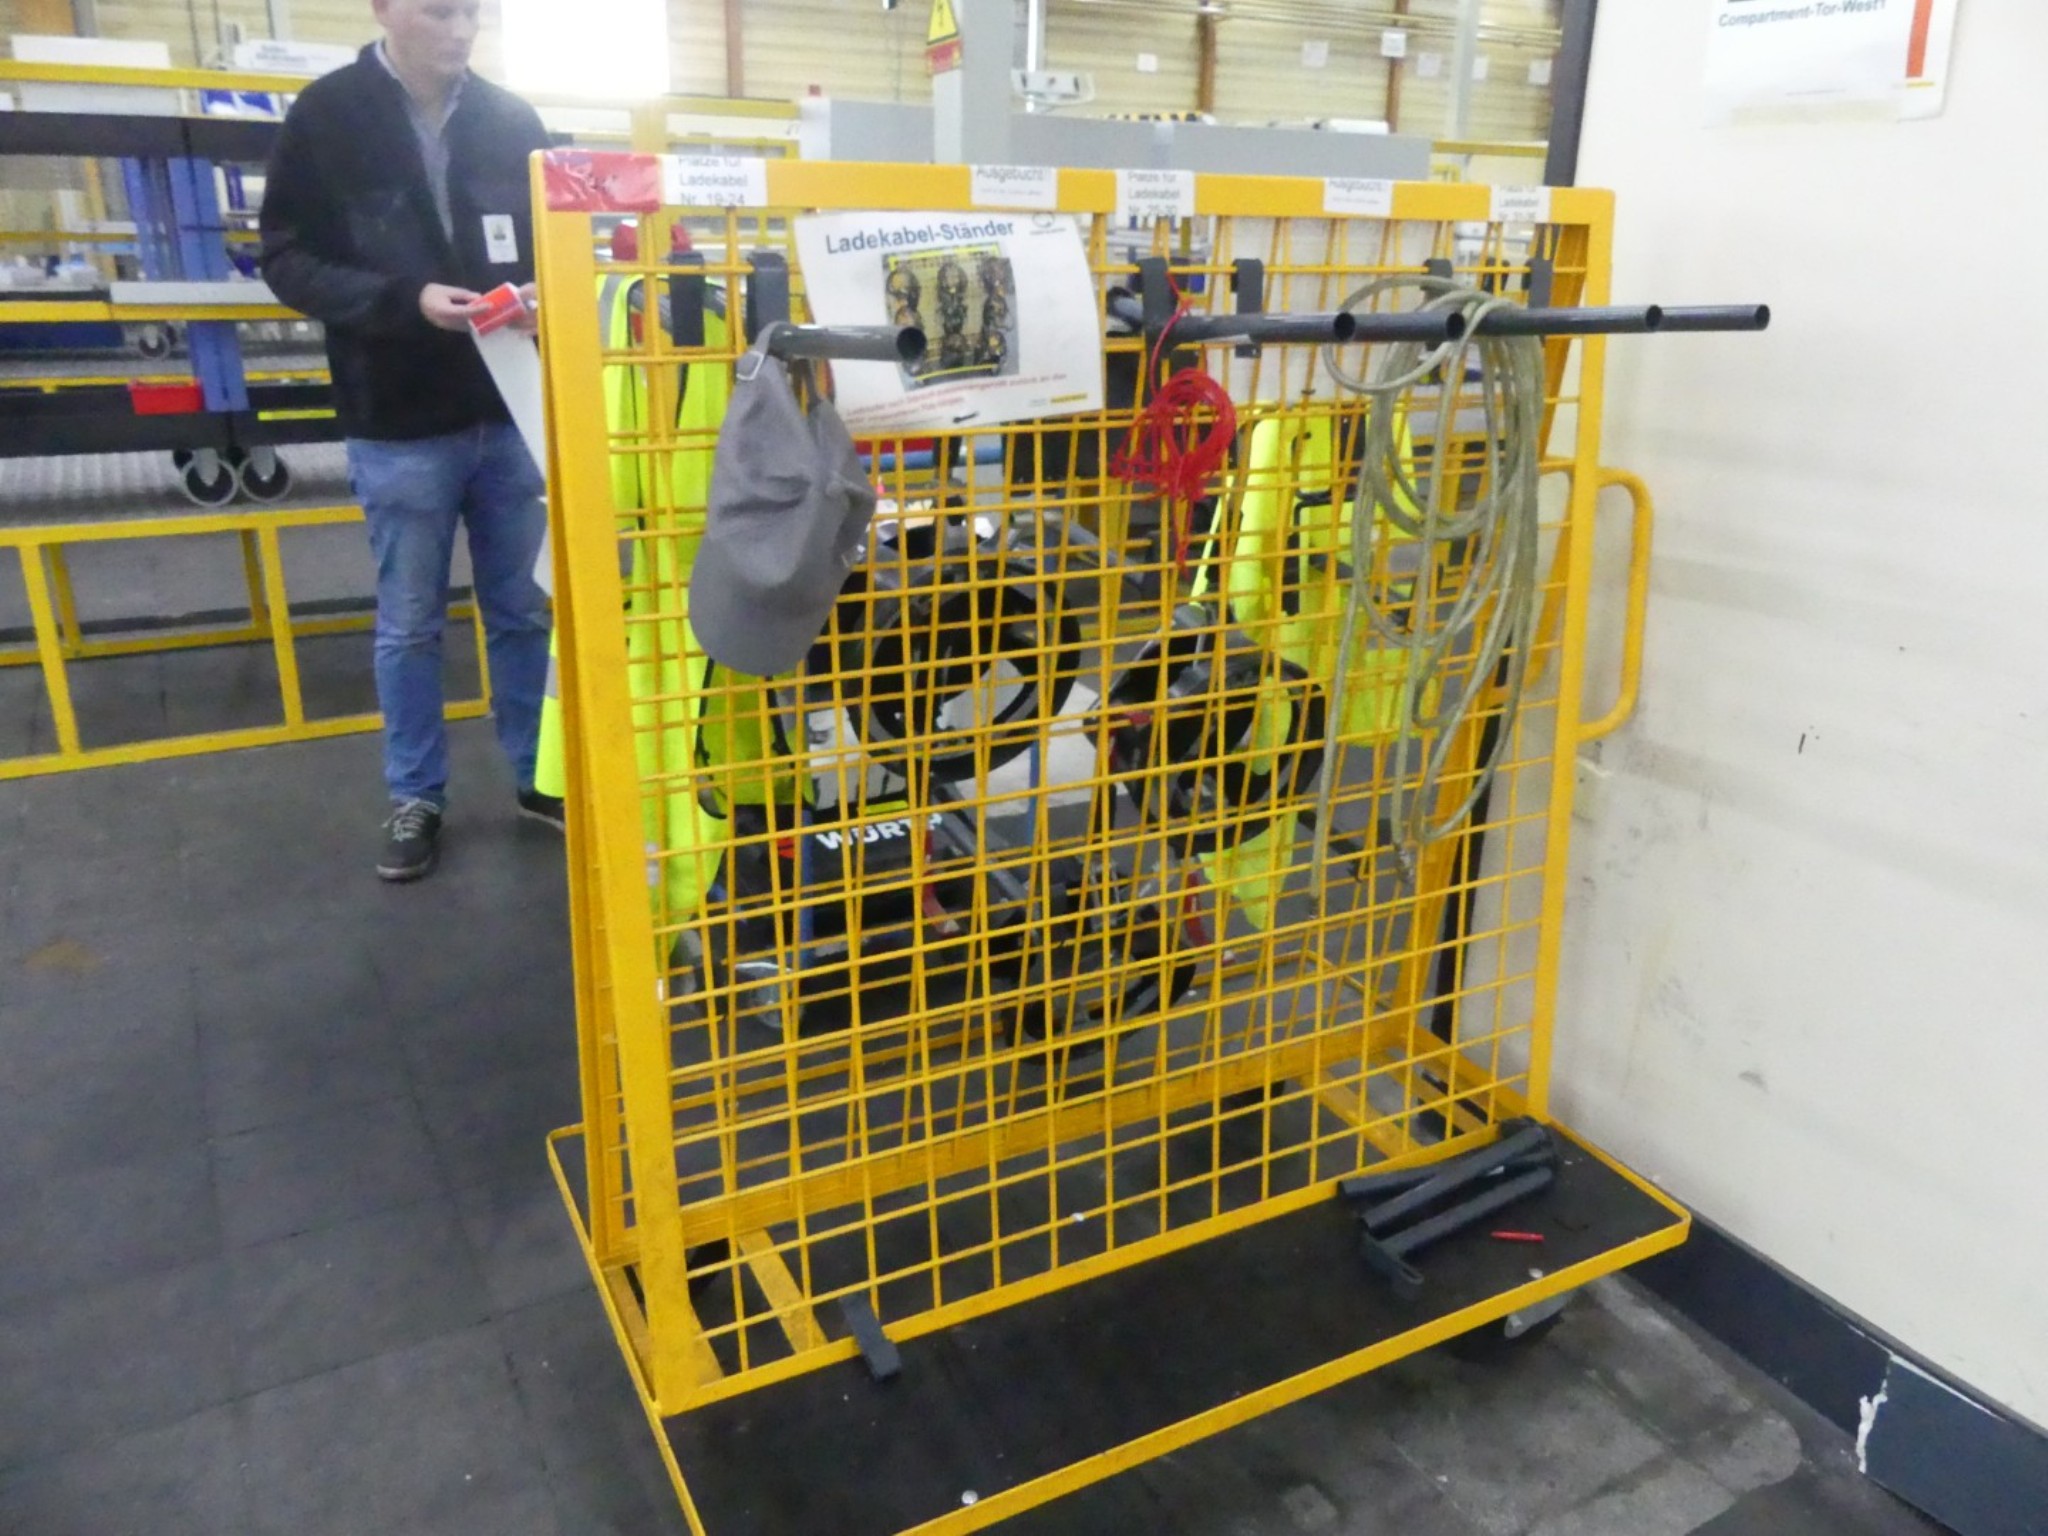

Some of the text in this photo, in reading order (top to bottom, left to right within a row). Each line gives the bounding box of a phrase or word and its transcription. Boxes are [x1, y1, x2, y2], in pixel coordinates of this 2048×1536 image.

[679, 173, 748, 187] Ladekabel
[1128, 187, 1180, 199] Ladekabel
[825, 220, 1015, 255] Ladekabel-Ständer
